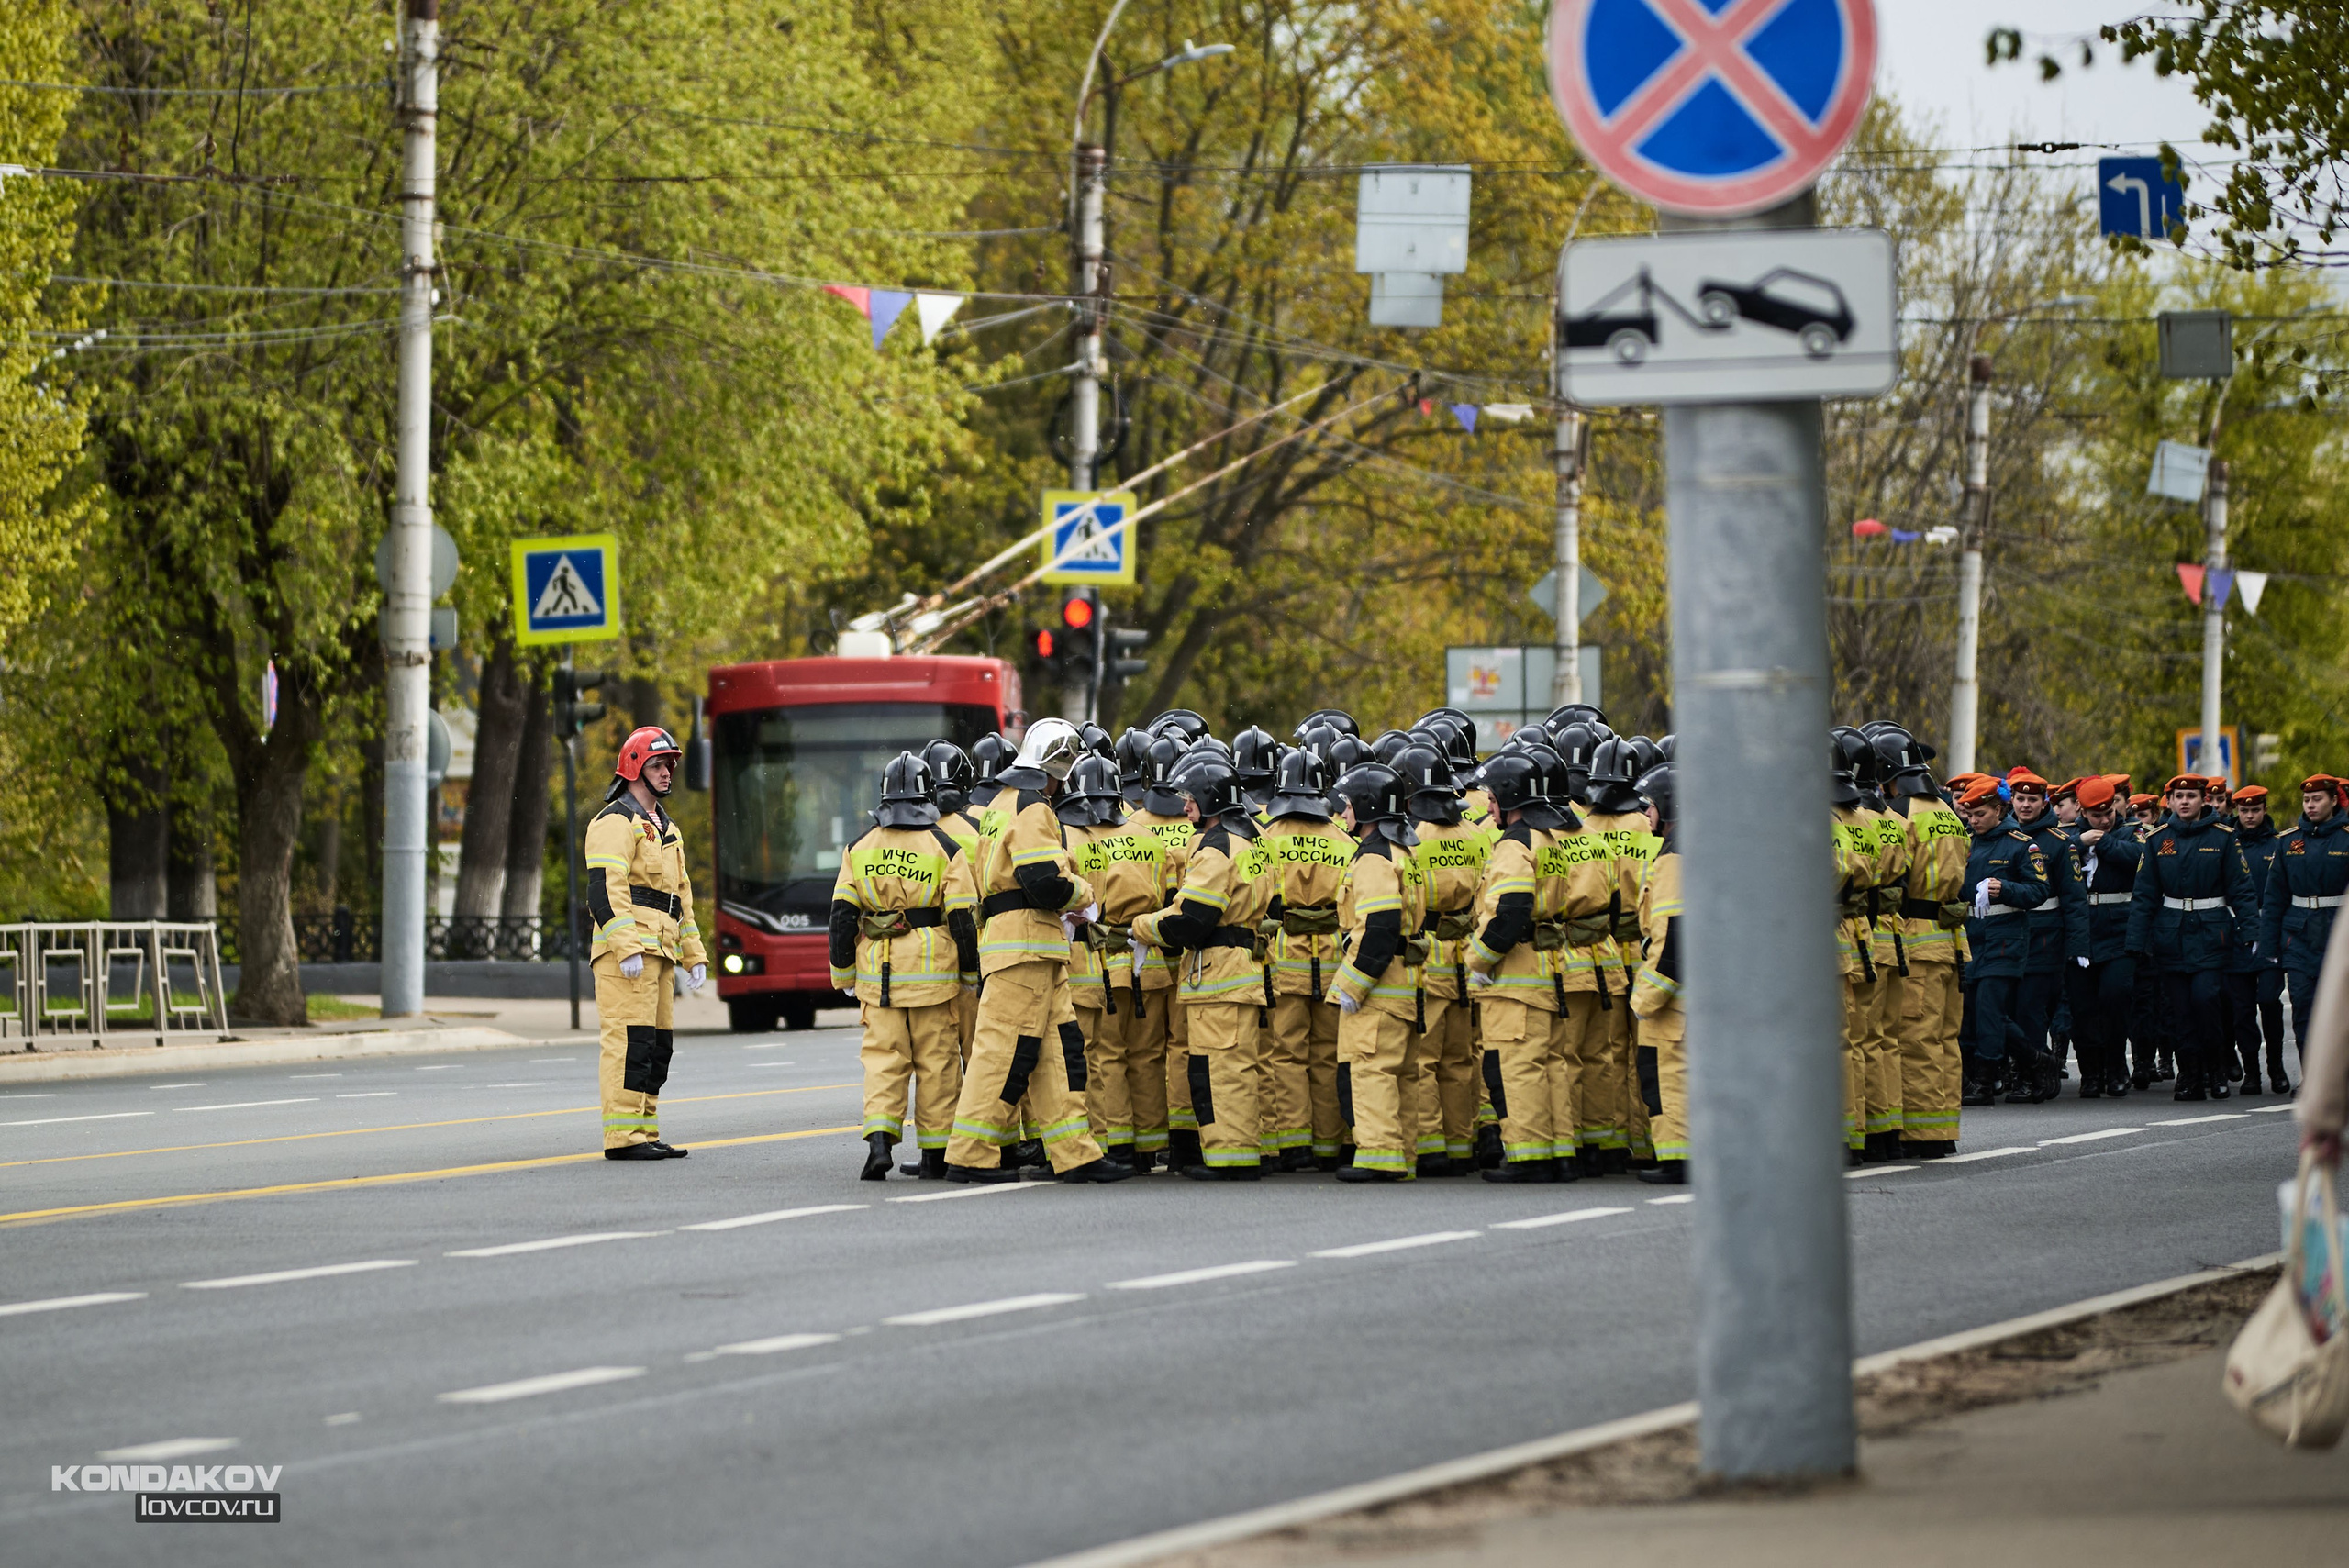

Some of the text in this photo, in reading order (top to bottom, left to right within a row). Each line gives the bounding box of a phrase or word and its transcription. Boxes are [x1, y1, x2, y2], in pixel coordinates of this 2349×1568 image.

[1151, 824, 1189, 837] МЧС
[1100, 836, 1135, 850] МЧС
[1292, 836, 1330, 850] МЧС
[1440, 840, 1465, 852] МЧС
[1558, 836, 1590, 850] МЧС
[883, 849, 918, 864] МЧС
[1108, 849, 1154, 862] ССИИ
[1279, 850, 1345, 867] РОССИИ
[1429, 854, 1475, 868] РОССИИ
[1565, 848, 1607, 863] ССИИ
[864, 863, 933, 884] РОССИИ
[780, 914, 810, 928] 005
